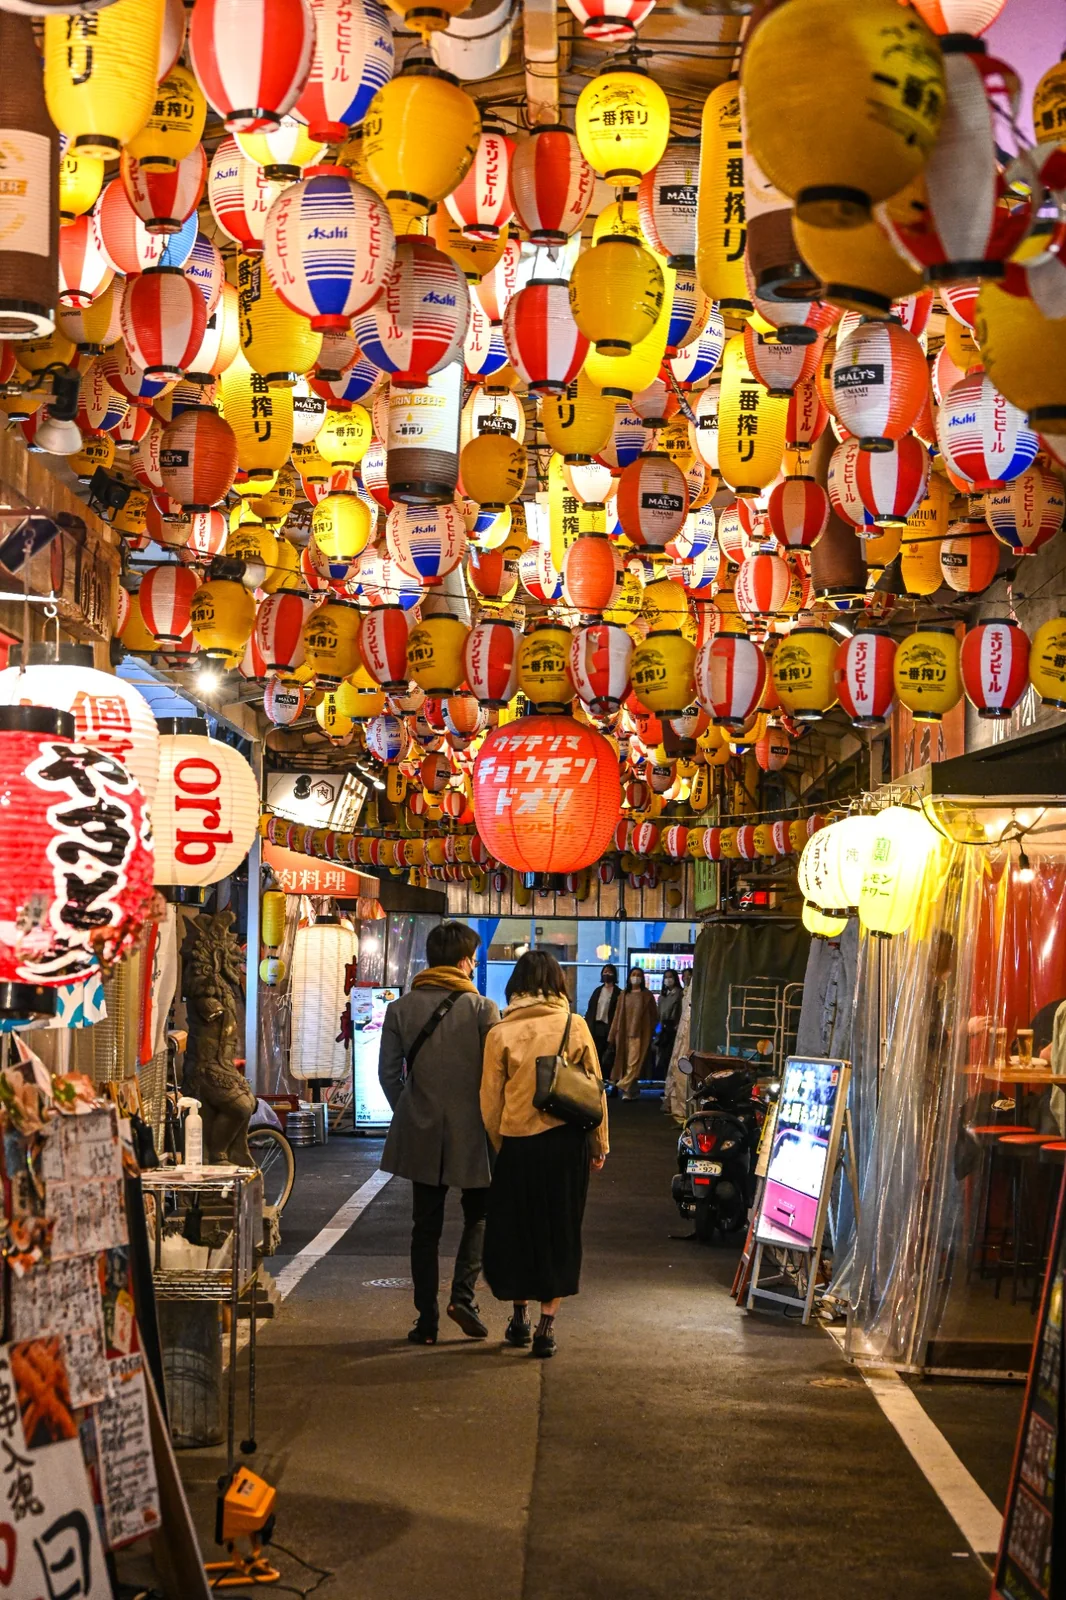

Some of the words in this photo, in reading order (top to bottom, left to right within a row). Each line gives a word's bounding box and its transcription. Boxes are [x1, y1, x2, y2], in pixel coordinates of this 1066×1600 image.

[589, 110, 649, 127] 一番搾り
[482, 139, 499, 207] キリンビール
[275, 198, 296, 285] アサヒビール
[308, 226, 348, 240] Asahi
[361, 201, 382, 285] アサヒビール
[186, 265, 212, 280] Asahi
[386, 261, 403, 339] アサヒビール
[423, 291, 456, 307] Asahi
[838, 370, 876, 383] MALT'S
[295, 401, 322, 411] MALT'S
[800, 383, 813, 432] キリンビール
[483, 420, 513, 430] MALT'S
[620, 417, 643, 427] Asah
[738, 378, 760, 462] 一番搾り
[948, 412, 976, 427] Asahi
[326, 427, 364, 438] 一番搾り
[396, 426, 424, 436] 一番搾り
[844, 444, 858, 503] アサヒビール
[648, 498, 680, 508] MALT'S
[991, 495, 1011, 505] Asahi
[1022, 476, 1035, 528] アサヒビール
[411, 525, 437, 534] Asahi
[442, 505, 456, 558] アサヒビール
[367, 617, 384, 670] キリンビール
[471, 631, 485, 686] キリンビール
[522, 660, 566, 673] 一番搾り
[572, 635, 585, 689] キリンビール
[988, 631, 1004, 694] キリンビール
[773, 667, 812, 682] 一番搾り
[855, 642, 869, 702] キリンビール
[899, 667, 946, 682] 一番搾り
[493, 735, 583, 752] ウラテンマ
[477, 756, 598, 785] チョウチン
[173, 757, 234, 866] orb
[495, 788, 574, 815] ドオリ
[276, 869, 347, 892] 肉料理
